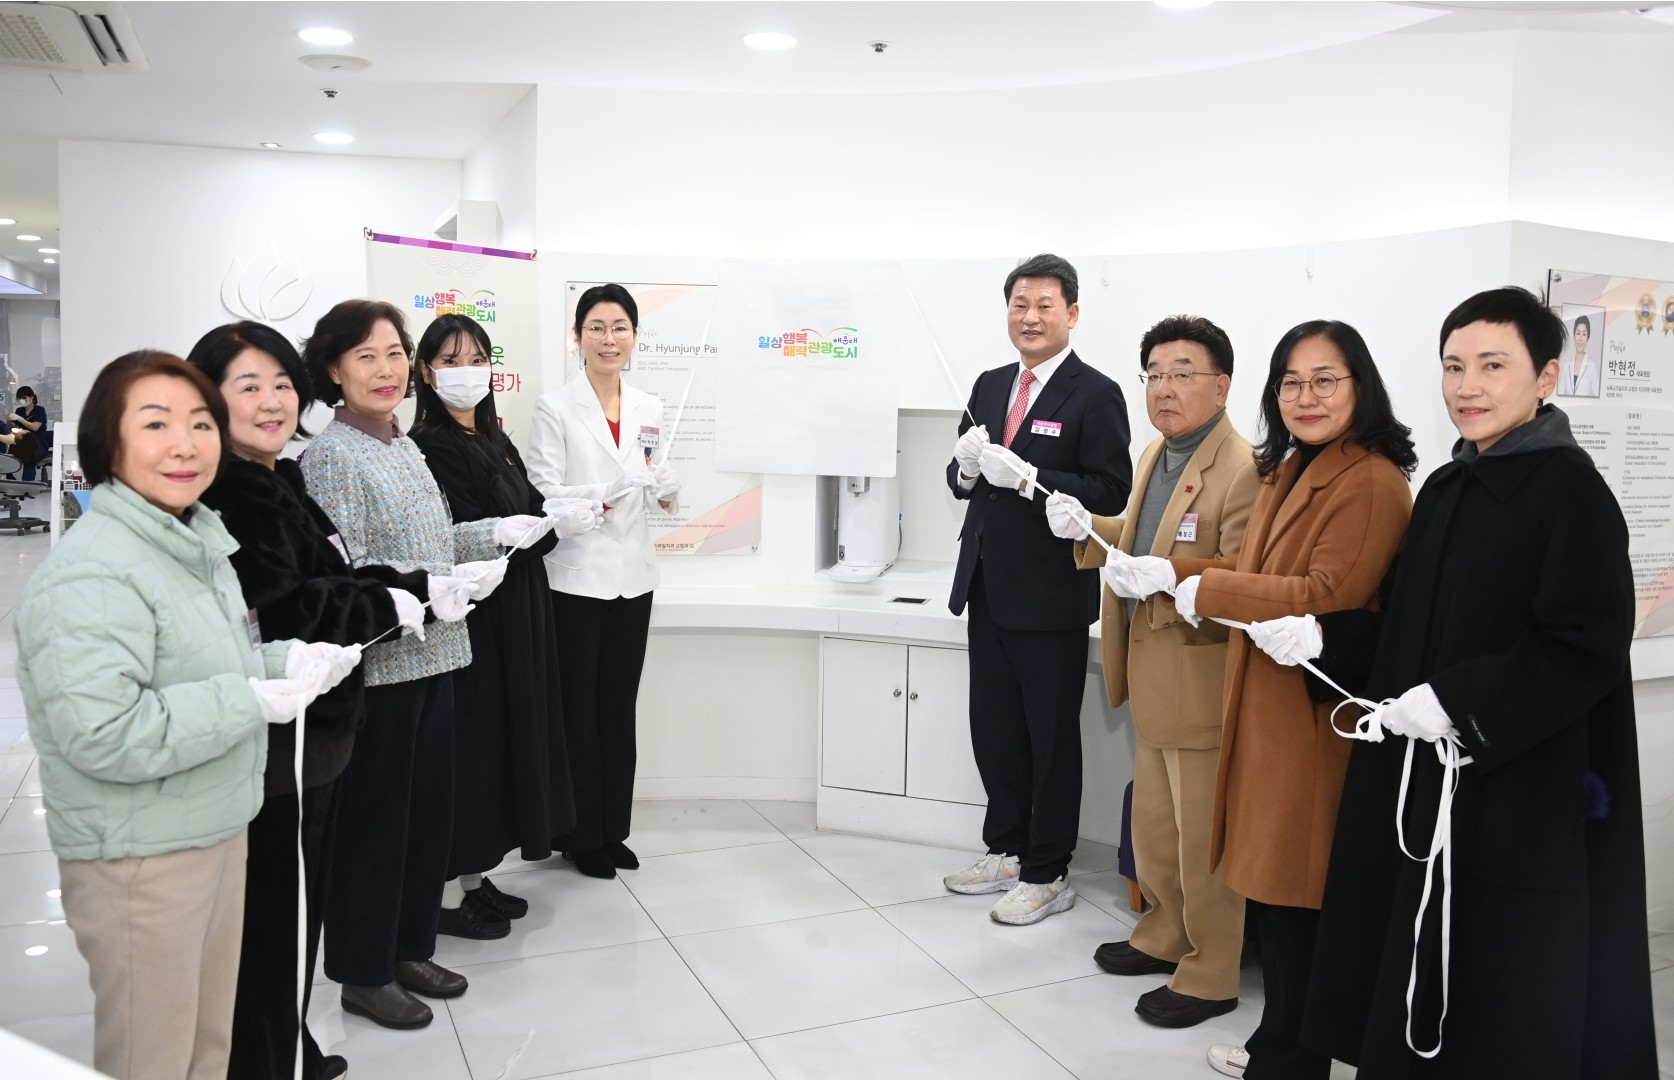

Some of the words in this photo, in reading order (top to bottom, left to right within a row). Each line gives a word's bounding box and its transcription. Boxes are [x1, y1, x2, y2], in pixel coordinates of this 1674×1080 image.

[638, 342, 653, 353] Dr.
[655, 343, 701, 356] Hyunjung
[1608, 359, 1636, 378] 박현정
